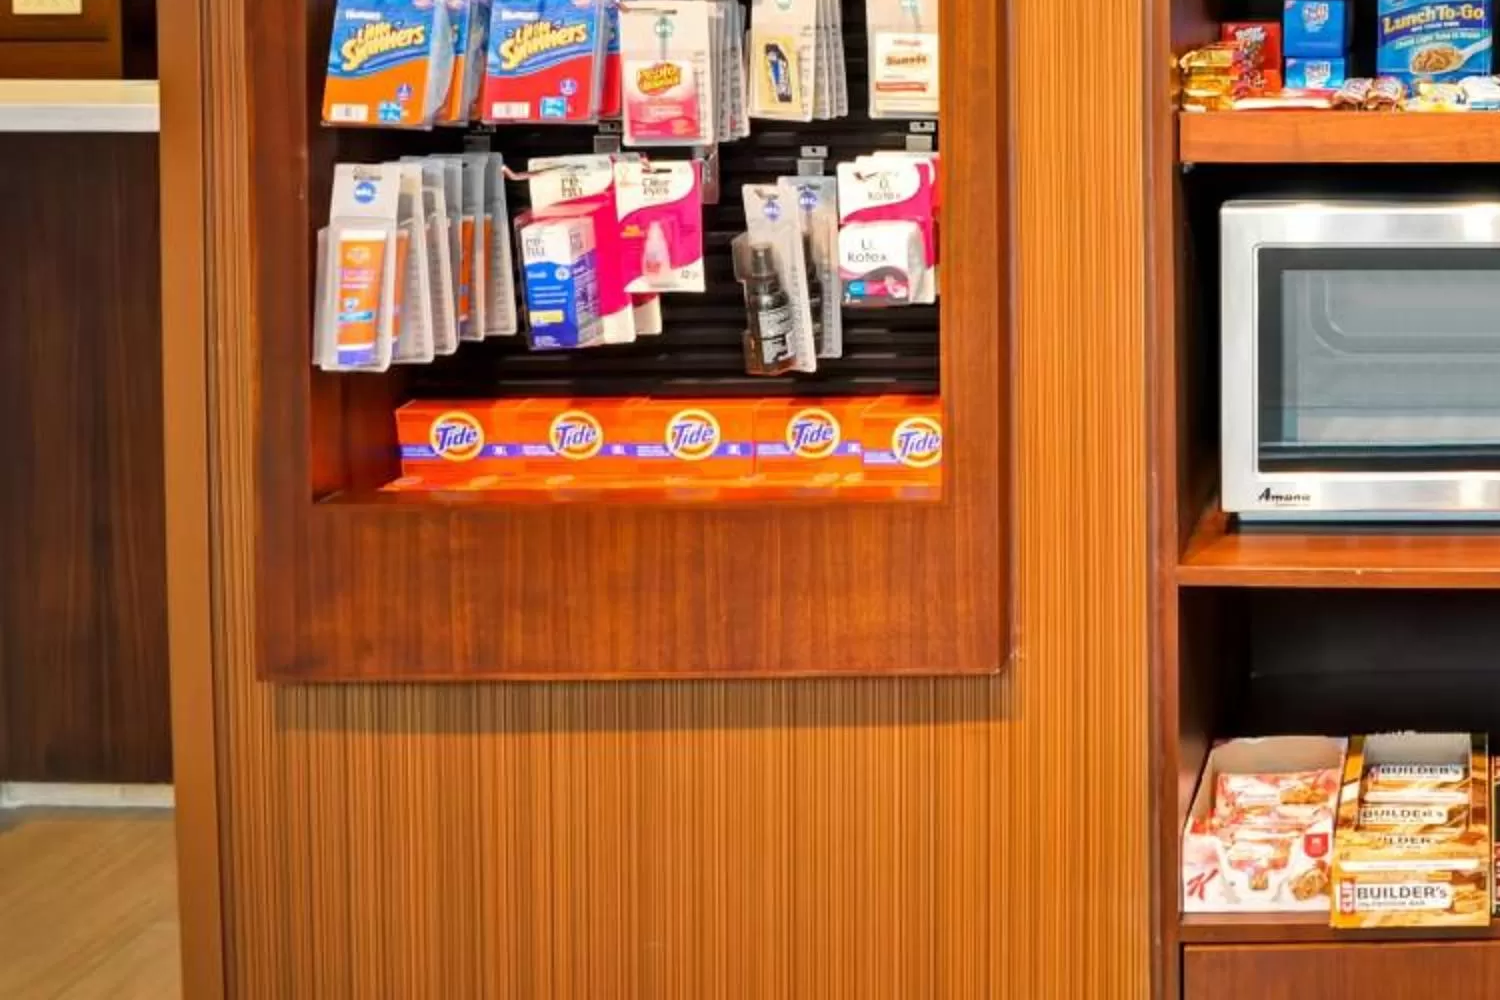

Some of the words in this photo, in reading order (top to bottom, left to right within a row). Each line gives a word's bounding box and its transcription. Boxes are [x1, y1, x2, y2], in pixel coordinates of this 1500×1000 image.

[1383, 6, 1436, 35] Lunch
[847, 250, 888, 263] Kotex
[436, 423, 479, 451] Tide
[555, 423, 598, 450] Tide
[672, 422, 715, 450] Tide
[792, 421, 835, 449] Tide
[899, 430, 941, 457] Tide
